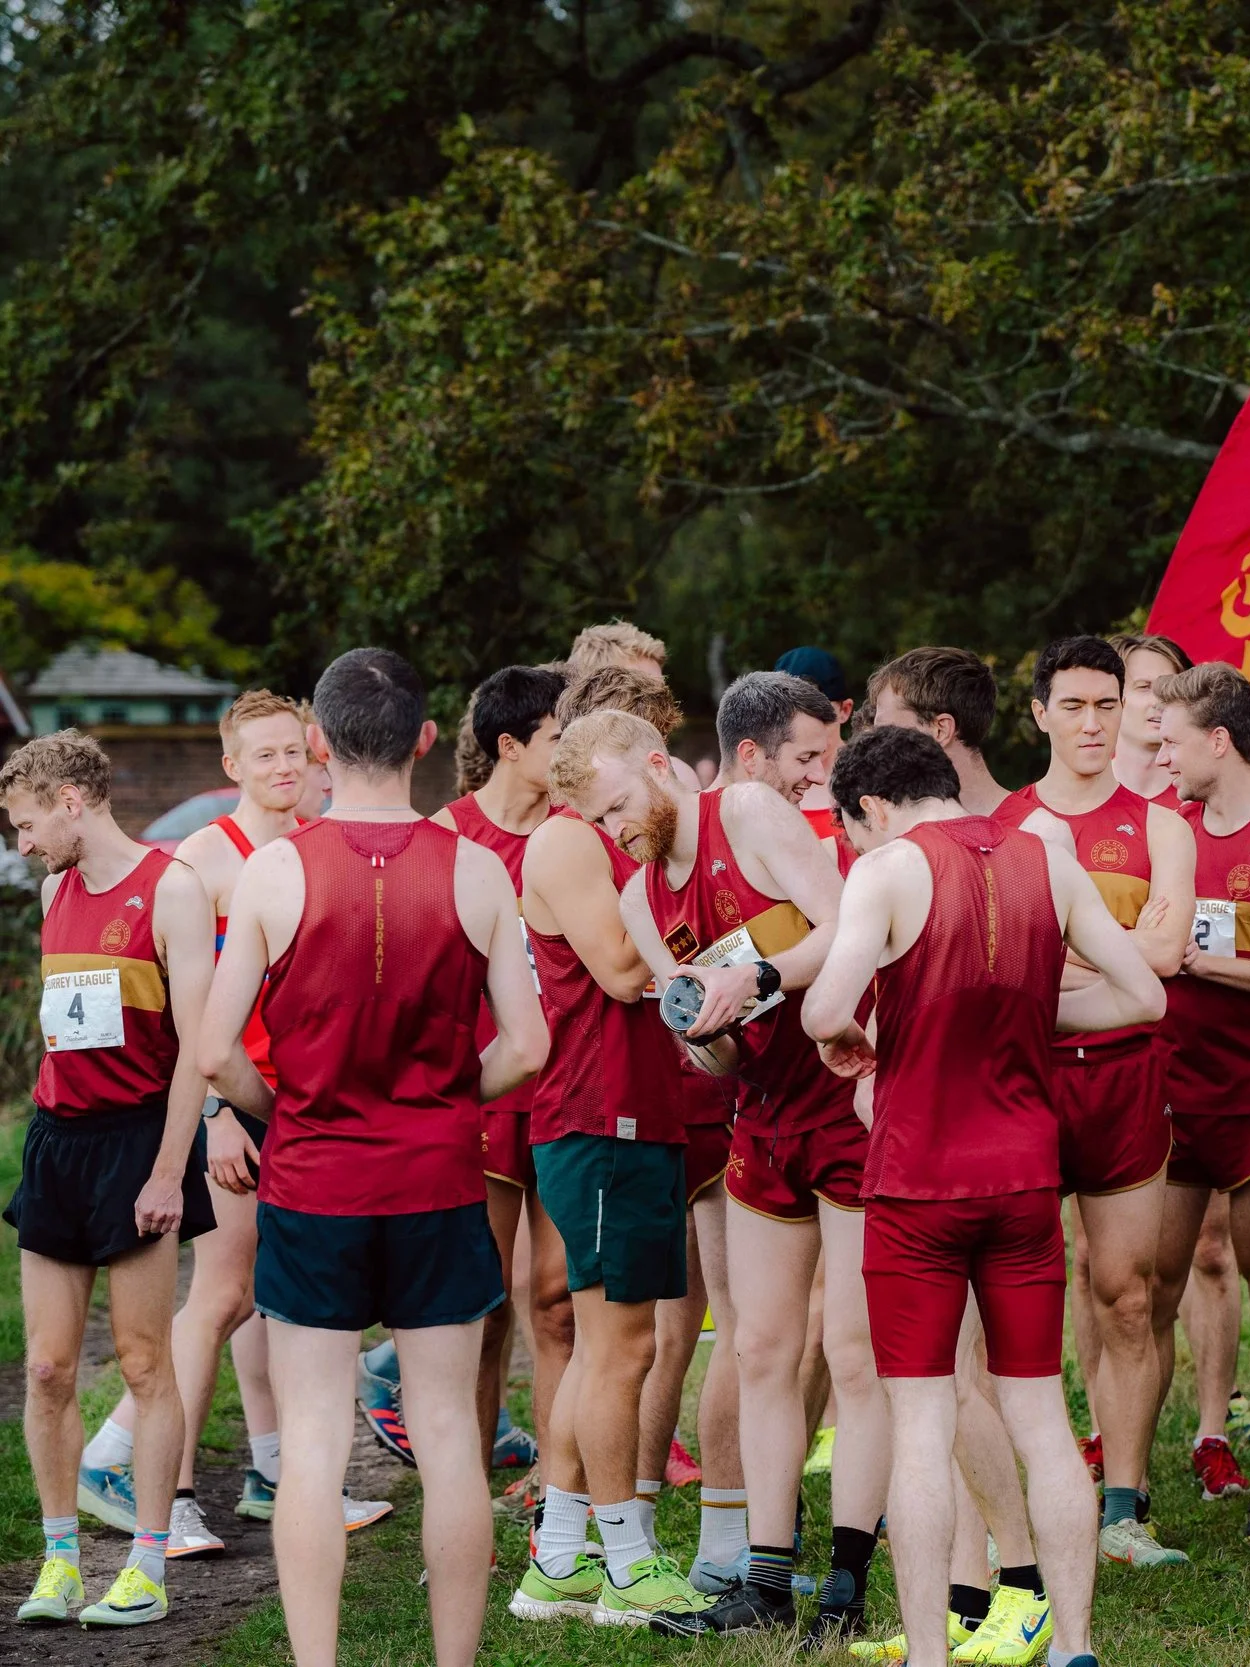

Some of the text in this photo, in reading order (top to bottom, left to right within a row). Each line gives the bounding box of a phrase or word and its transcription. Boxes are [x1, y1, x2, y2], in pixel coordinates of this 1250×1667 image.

[375, 878, 384, 984] BELGRAVE
[985, 867, 997, 973] BELGRAVE
[715, 933, 745, 959] LEAGUE
[74, 973, 112, 987] LEAGUE
[67, 993, 85, 1025] 4
